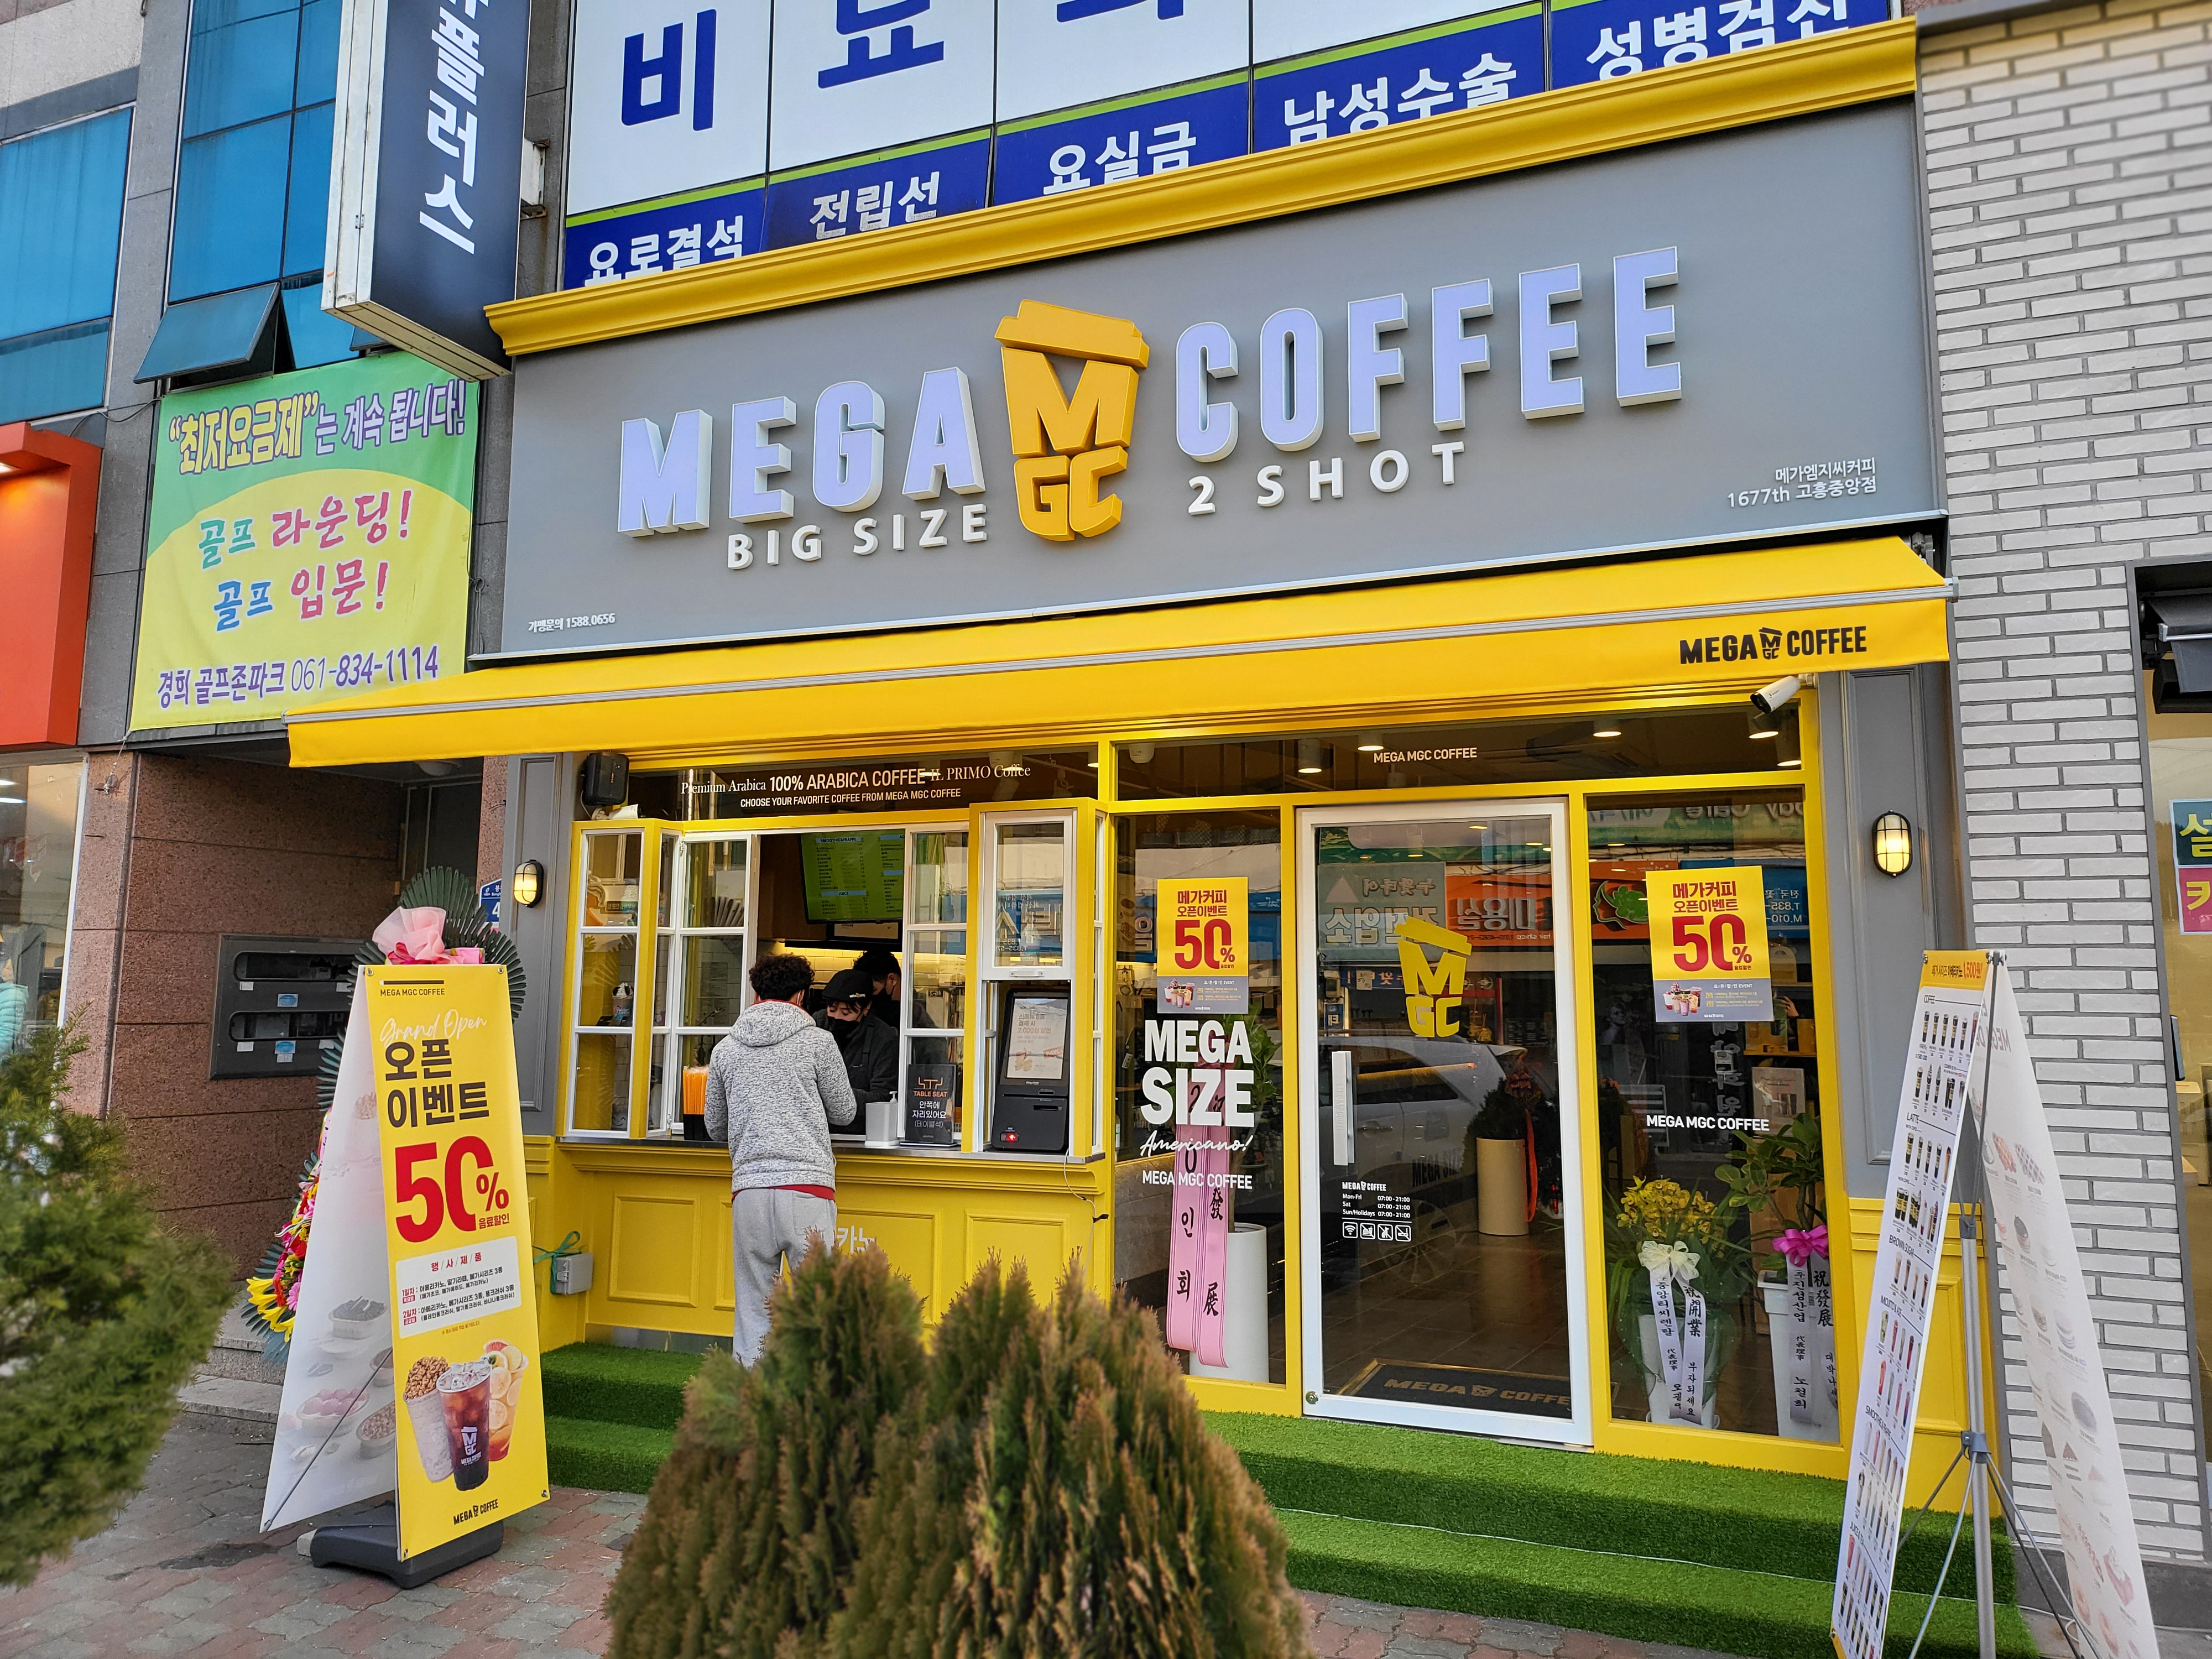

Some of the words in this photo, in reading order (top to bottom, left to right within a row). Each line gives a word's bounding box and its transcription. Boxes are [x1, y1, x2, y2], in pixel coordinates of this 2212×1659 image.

[1284, 53, 1517, 147] 남성수술
[1044, 121, 1197, 196] 요실금
[810, 171, 940, 241] 전립선
[585, 215, 745, 288] 요로결석
[1176, 245, 1682, 463] COFFEE
[343, 394, 384, 452] 계속
[390, 380, 466, 442] 됩니다!
[618, 366, 986, 538] MEGA
[1775, 457, 1876, 484] 메가엠지씨커피
[1187, 476, 1216, 515] 2
[1728, 486, 1790, 508] 1677th
[1796, 476, 1877, 500] 고흥중앙점
[198, 518, 257, 570] 골프
[272, 489, 414, 550] 라운딩!
[727, 524, 822, 570] BIG
[853, 503, 988, 556] SIZE
[213, 580, 274, 632] 골프
[290, 559, 388, 620] 입문!
[528, 617, 564, 633] 가맹문의
[566, 613, 615, 629] 1588.0656
[1680, 634, 1757, 665] MEGA
[1787, 625, 1867, 656] COFFEE
[158, 669, 190, 709] 경희
[195, 662, 285, 701] 골프존파크
[291, 645, 440, 692] 061-834-1114
[1373, 751, 1406, 764] MEGA
[1407, 749, 1432, 762] MGC
[1433, 747, 1478, 760] COFFEE
[681, 780, 726, 795] Premium
[728, 779, 766, 792] Arabica
[769, 775, 804, 792] 100%
[806, 771, 869, 791] ARABICA
[872, 768, 926, 787] COFFEE
[946, 766, 990, 780] PRIMO
[994, 763, 1031, 779] Coffee
[740, 797, 770, 807] CHOOSE
[772, 796, 792, 806] YOUR
[794, 794, 829, 805] FAVORITE
[831, 793, 860, 804] COFFEE
[861, 792, 884, 802] FROM
[885, 790, 909, 801] MEGA
[910, 789, 929, 800] MGC
[931, 788, 961, 799] COFFEE
[1177, 890, 1227, 904] 메가커피
[1672, 880, 1737, 899] 메가커피
[1177, 905, 1228, 917] 오픈이벤트
[1673, 898, 1739, 914] 오픈이벤트
[1175, 919, 1235, 969] 50%
[1672, 914, 1752, 972] 50%
[419, 988, 445, 996] COFFEE
[444, 1009, 487, 1040] Open
[1144, 1020, 1253, 1062] MEGA
[385, 1039, 452, 1082] 오픈
[387, 1081, 489, 1128] 이벤트
[919, 1100, 940, 1109] 안쪽에
[1140, 1067, 1254, 1128] SIZE
[912, 1110, 947, 1119] 자리있어요
[914, 1120, 943, 1128] (테이블석)
[1646, 1114, 1684, 1128] MEGA
[1686, 1115, 1716, 1130] MGC
[1718, 1117, 1770, 1131] COFFEE
[1906, 1112, 1919, 1124] LATTE
[1140, 1130, 1253, 1157] Americano!
[395, 1135, 510, 1244] 50%
[1142, 1170, 1175, 1186] MEGA
[1178, 1171, 1204, 1187] MGC
[1207, 1173, 1253, 1190] COFFEE
[1342, 1182, 1361, 1190] MEGA
[1367, 1183, 1386, 1191] COFFEE
[479, 1213, 510, 1229] 음료할인
[1342, 1209, 1375, 1217] Sun/Holidays
[402, 1286, 415, 1297] 1일차
[419, 1280, 446, 1293] 아메리카노,
[469, 1268, 493, 1281] 메가시리즈
[494, 1266, 503, 1275] 3종
[403, 1307, 416, 1318] 2일차
[421, 1301, 448, 1314] 아메리카노,
[448, 1294, 473, 1307] 메가시리즈
[505, 1284, 515, 1292] 3종
[1686, 1362, 1697, 1416] 부자되세요
[453, 1510, 473, 1525] MEGA
[479, 1499, 499, 1515] COFFEE
